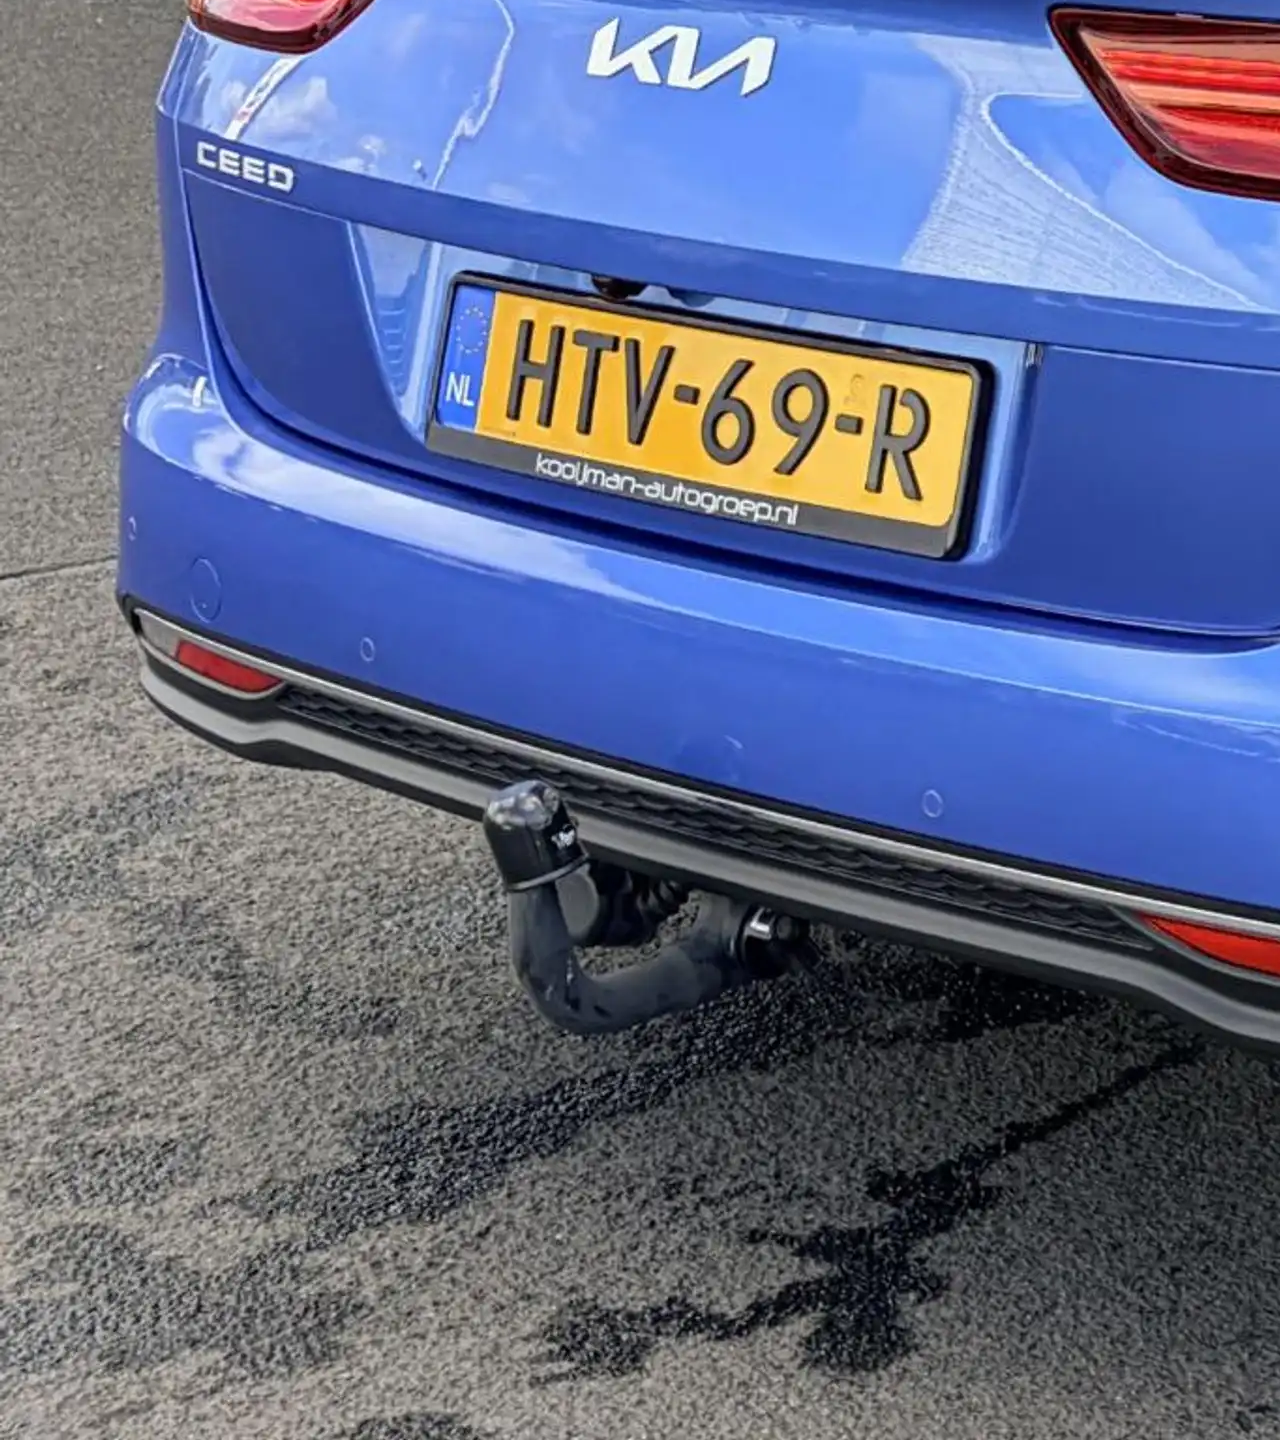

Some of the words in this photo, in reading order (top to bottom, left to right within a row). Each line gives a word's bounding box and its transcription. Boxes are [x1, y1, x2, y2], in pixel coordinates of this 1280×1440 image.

[587, 18, 776, 97] KIA
[197, 140, 294, 192] CEED
[445, 371, 475, 408] NL
[505, 319, 931, 501] HTV-69-R
[535, 452, 798, 526] kooijman-autogroep.nl
